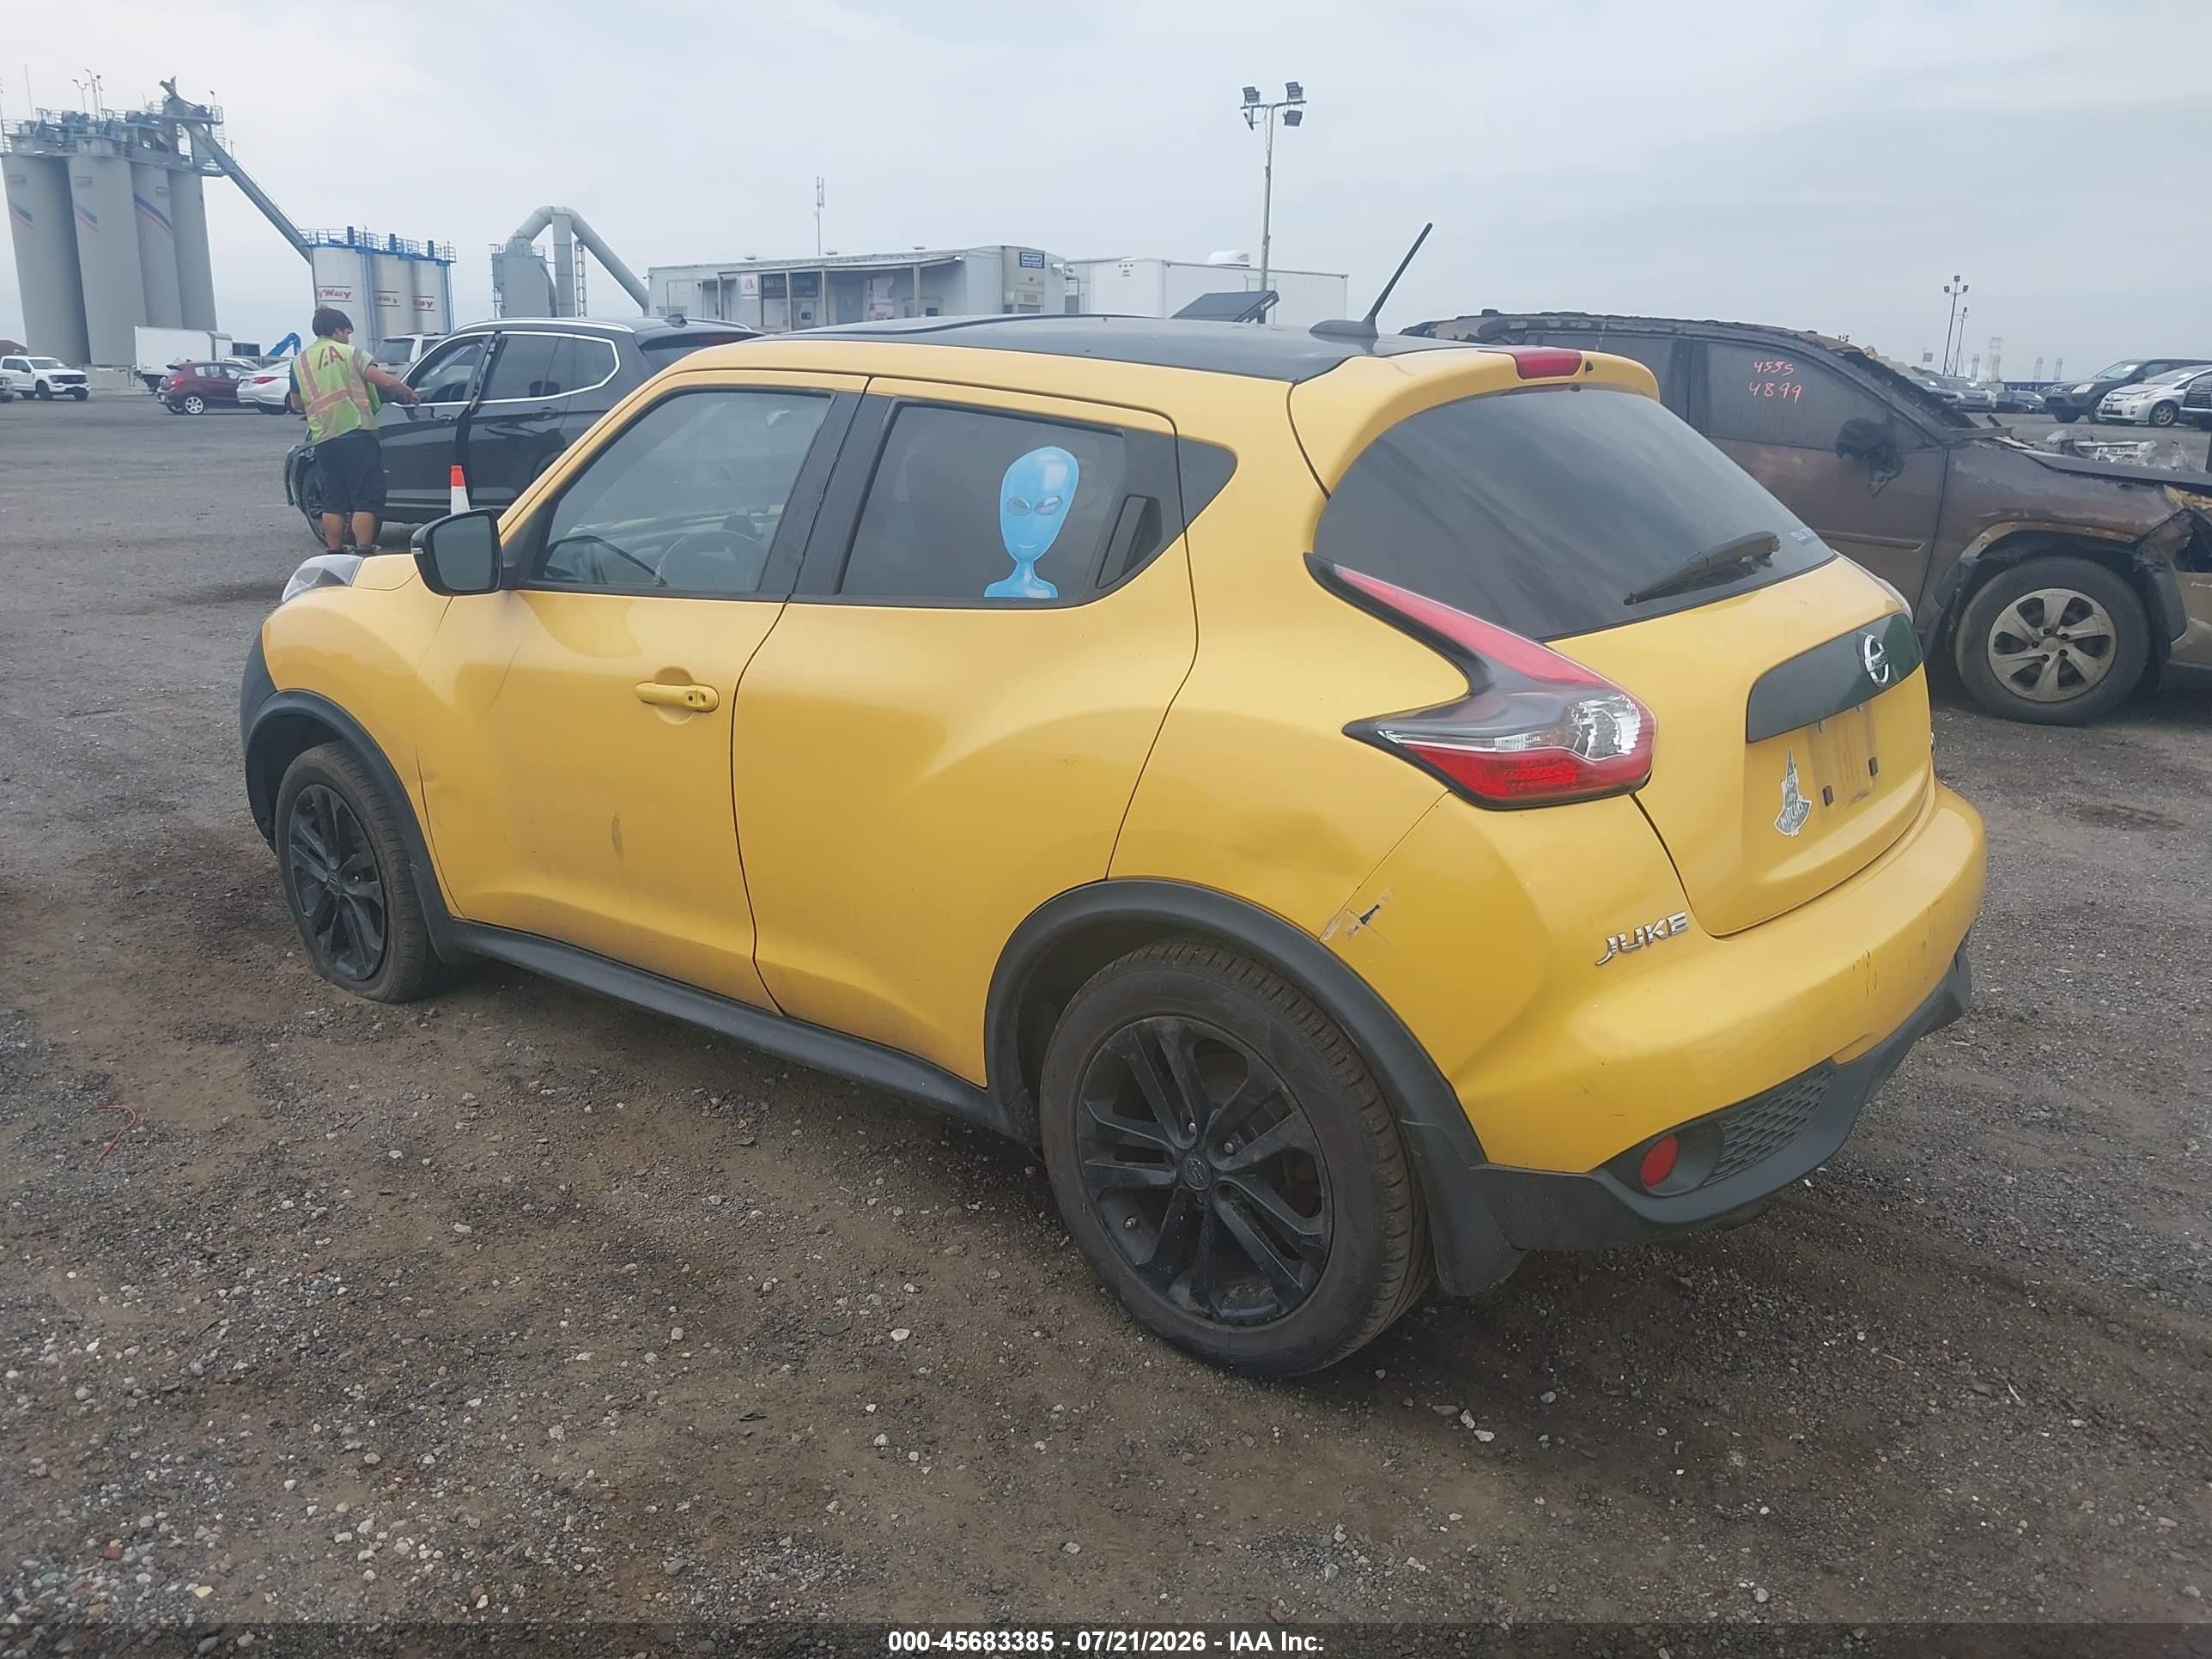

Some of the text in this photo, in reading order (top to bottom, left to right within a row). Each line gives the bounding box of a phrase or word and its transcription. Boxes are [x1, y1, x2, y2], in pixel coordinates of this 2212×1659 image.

[1753, 361, 1794, 376] 4555
[1749, 381, 1802, 404] 4899
[1594, 910, 1688, 966] JUKE
